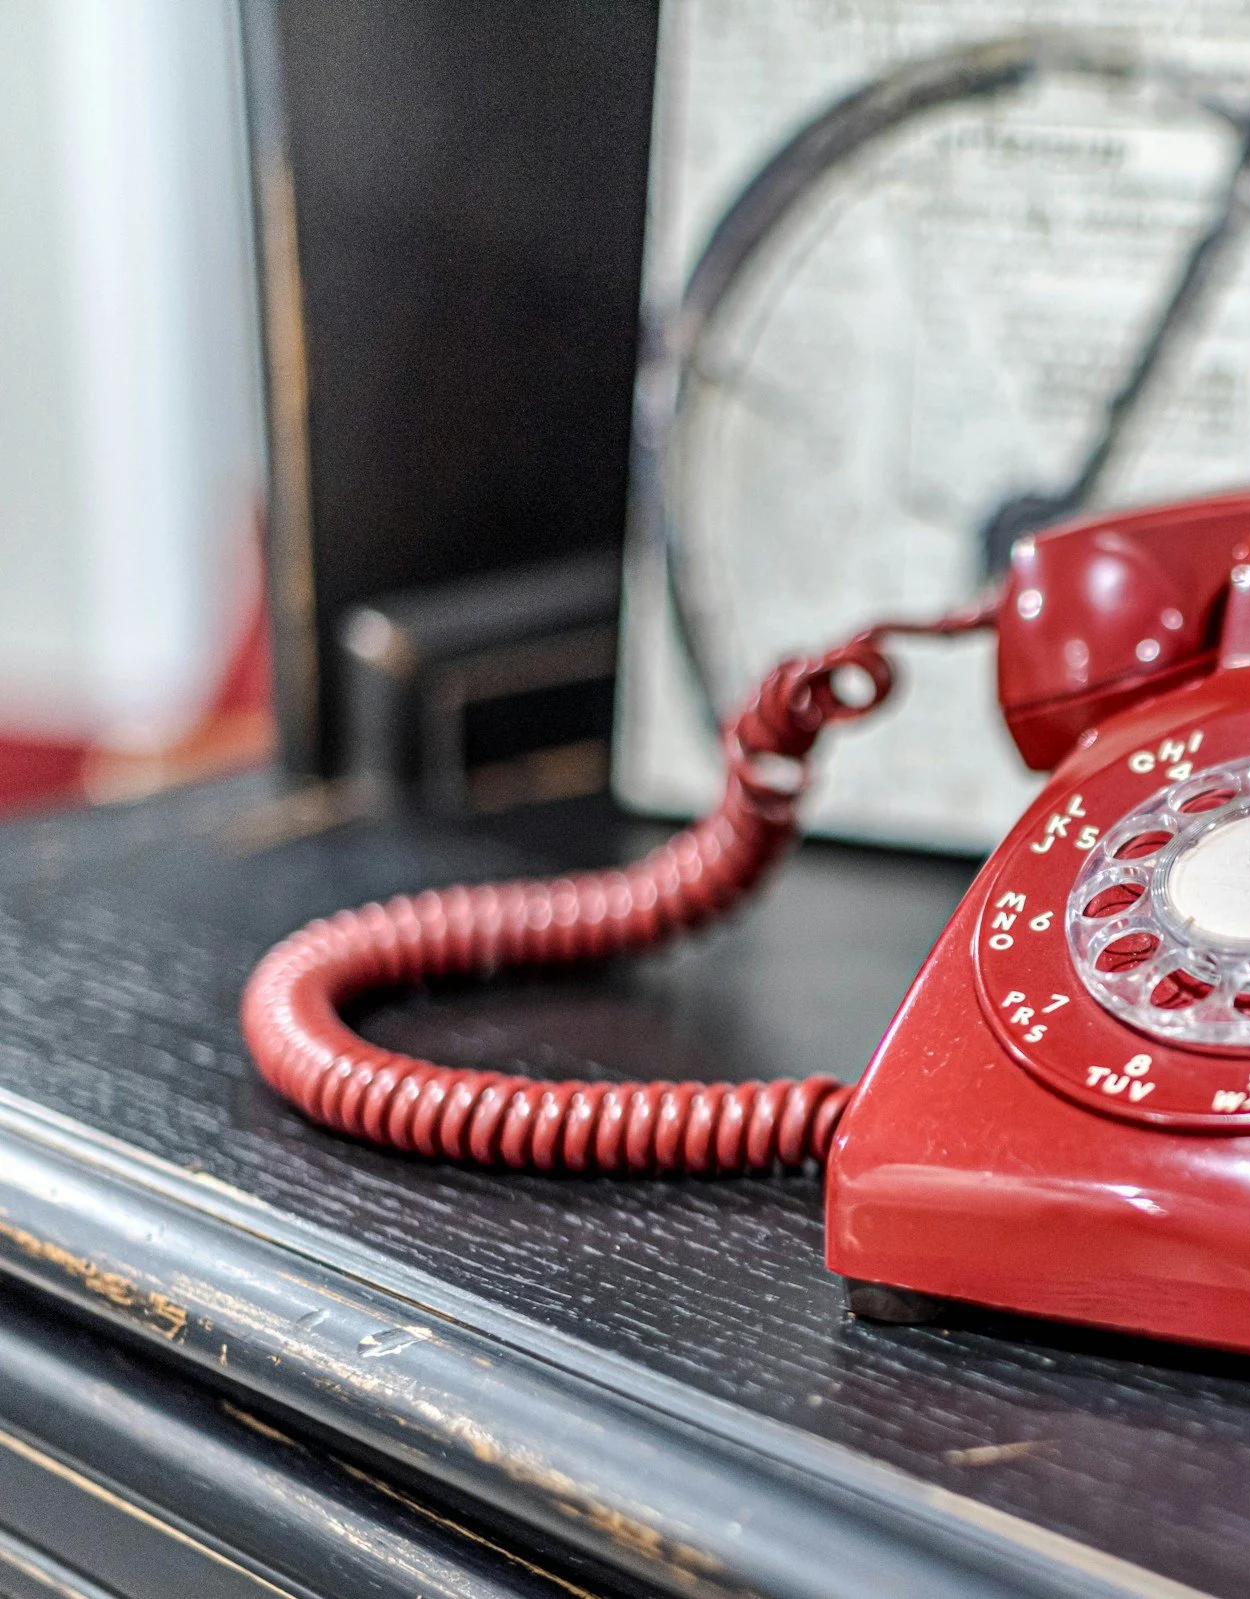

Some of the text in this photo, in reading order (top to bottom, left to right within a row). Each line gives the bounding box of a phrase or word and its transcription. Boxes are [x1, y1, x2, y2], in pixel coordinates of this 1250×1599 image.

[1128, 731, 1203, 773] GHI
[1165, 760, 1194, 781] 4
[1031, 794, 1086, 854] JKL
[1075, 826, 1100, 850] 5
[988, 891, 1027, 950] MNO
[1029, 911, 1054, 932] 6
[1001, 990, 1048, 1043] PRS
[1042, 993, 1070, 1013] 7
[1124, 1053, 1153, 1077] 8
[1086, 1065, 1156, 1102] TUV
